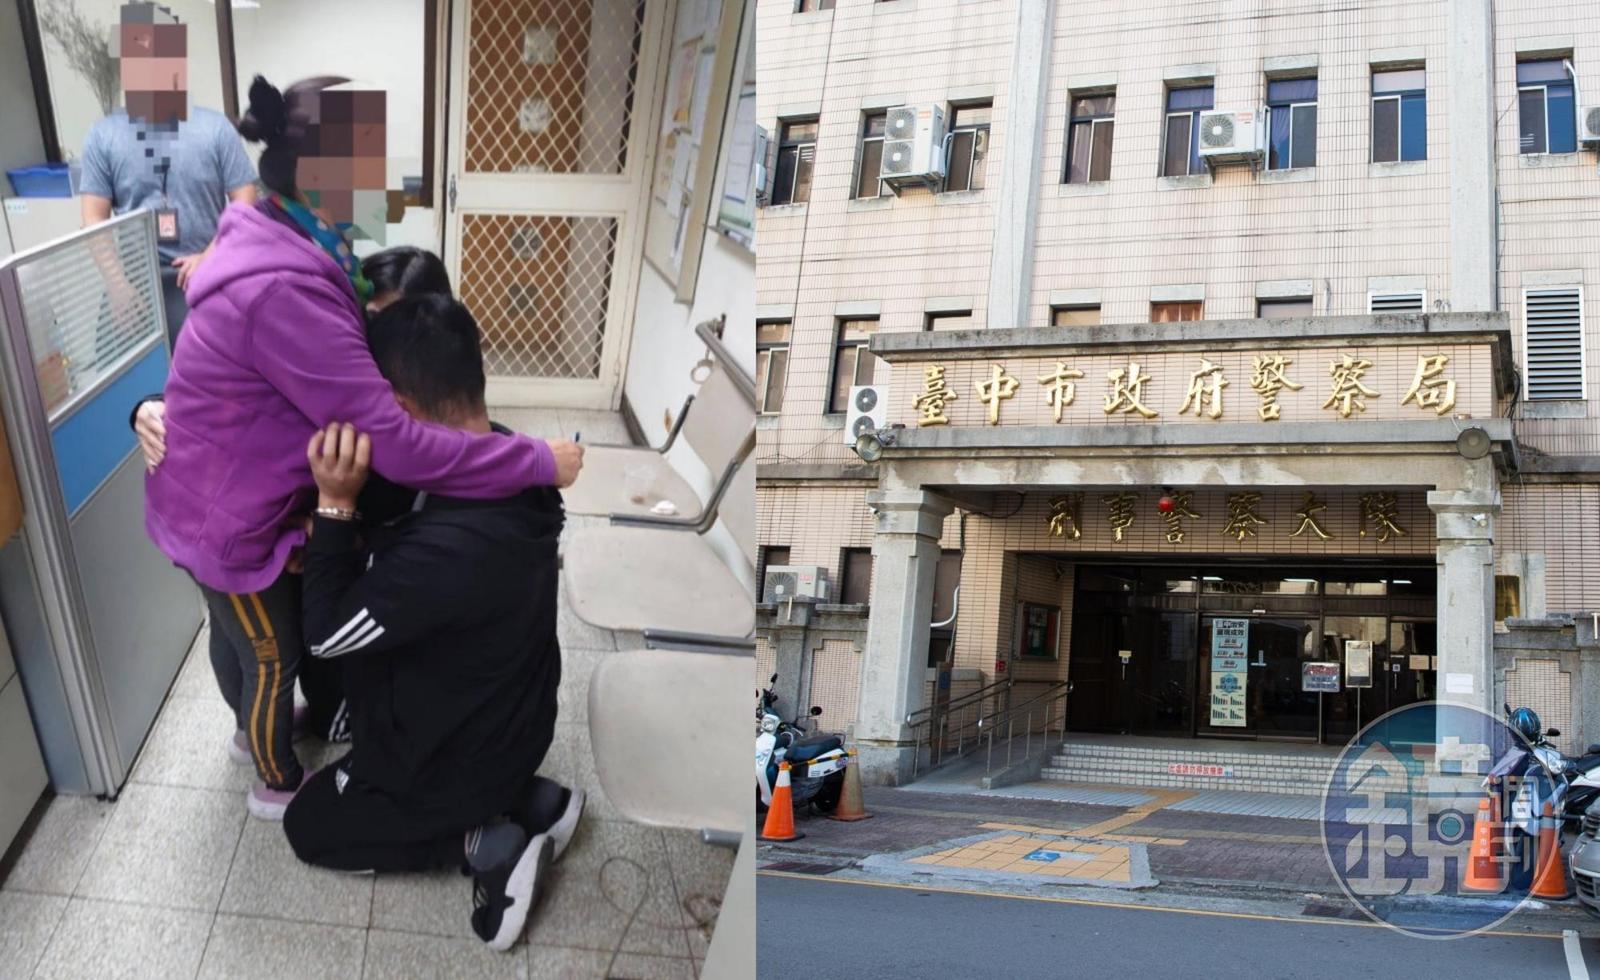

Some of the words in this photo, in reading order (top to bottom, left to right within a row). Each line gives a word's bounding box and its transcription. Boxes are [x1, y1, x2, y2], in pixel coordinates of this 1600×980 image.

[911, 353, 1458, 427] 臺中市政府警察局
[1044, 490, 1406, 544] 刑事警察大隊
